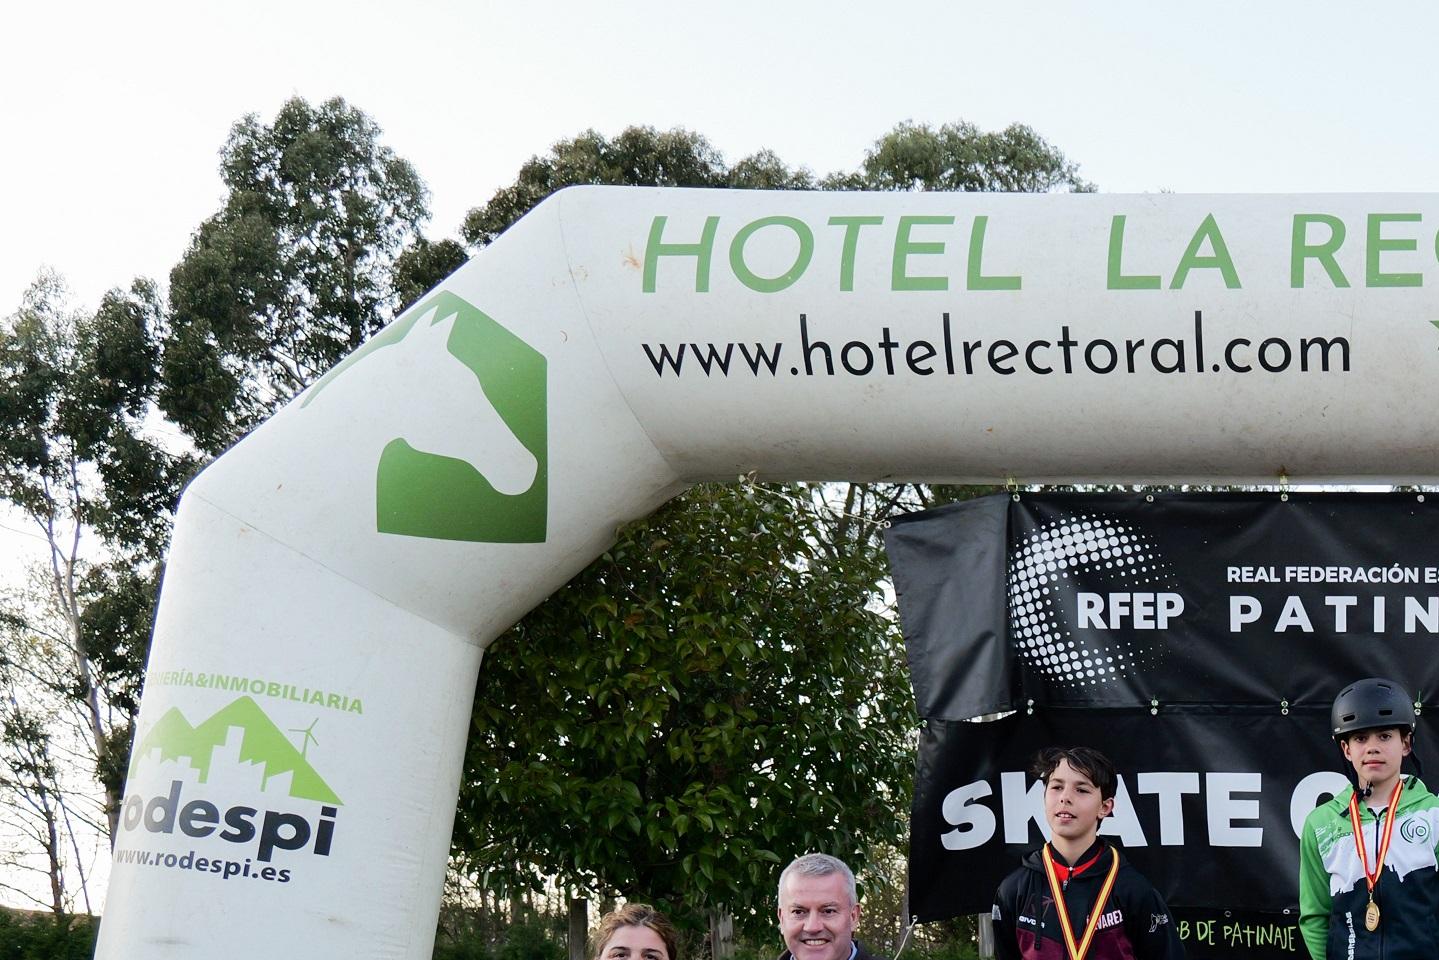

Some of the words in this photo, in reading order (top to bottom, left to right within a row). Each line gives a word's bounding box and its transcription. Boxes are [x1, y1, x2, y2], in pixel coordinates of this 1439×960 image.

[641, 214, 1022, 294] HOTEL
[1106, 211, 1243, 291] LA
[641, 310, 1351, 377] www.hotelrectoral.com
[1227, 566, 1281, 583] REAL
[1284, 562, 1420, 585] FEDERACIÓN
[1076, 591, 1185, 630] RFEP
[123, 780, 338, 863] odespi
[940, 771, 1264, 851] SKATE
[117, 848, 292, 883] www.rodespi.es
[1196, 920, 1216, 946] DE
[1223, 924, 1297, 951] PATINAJE
